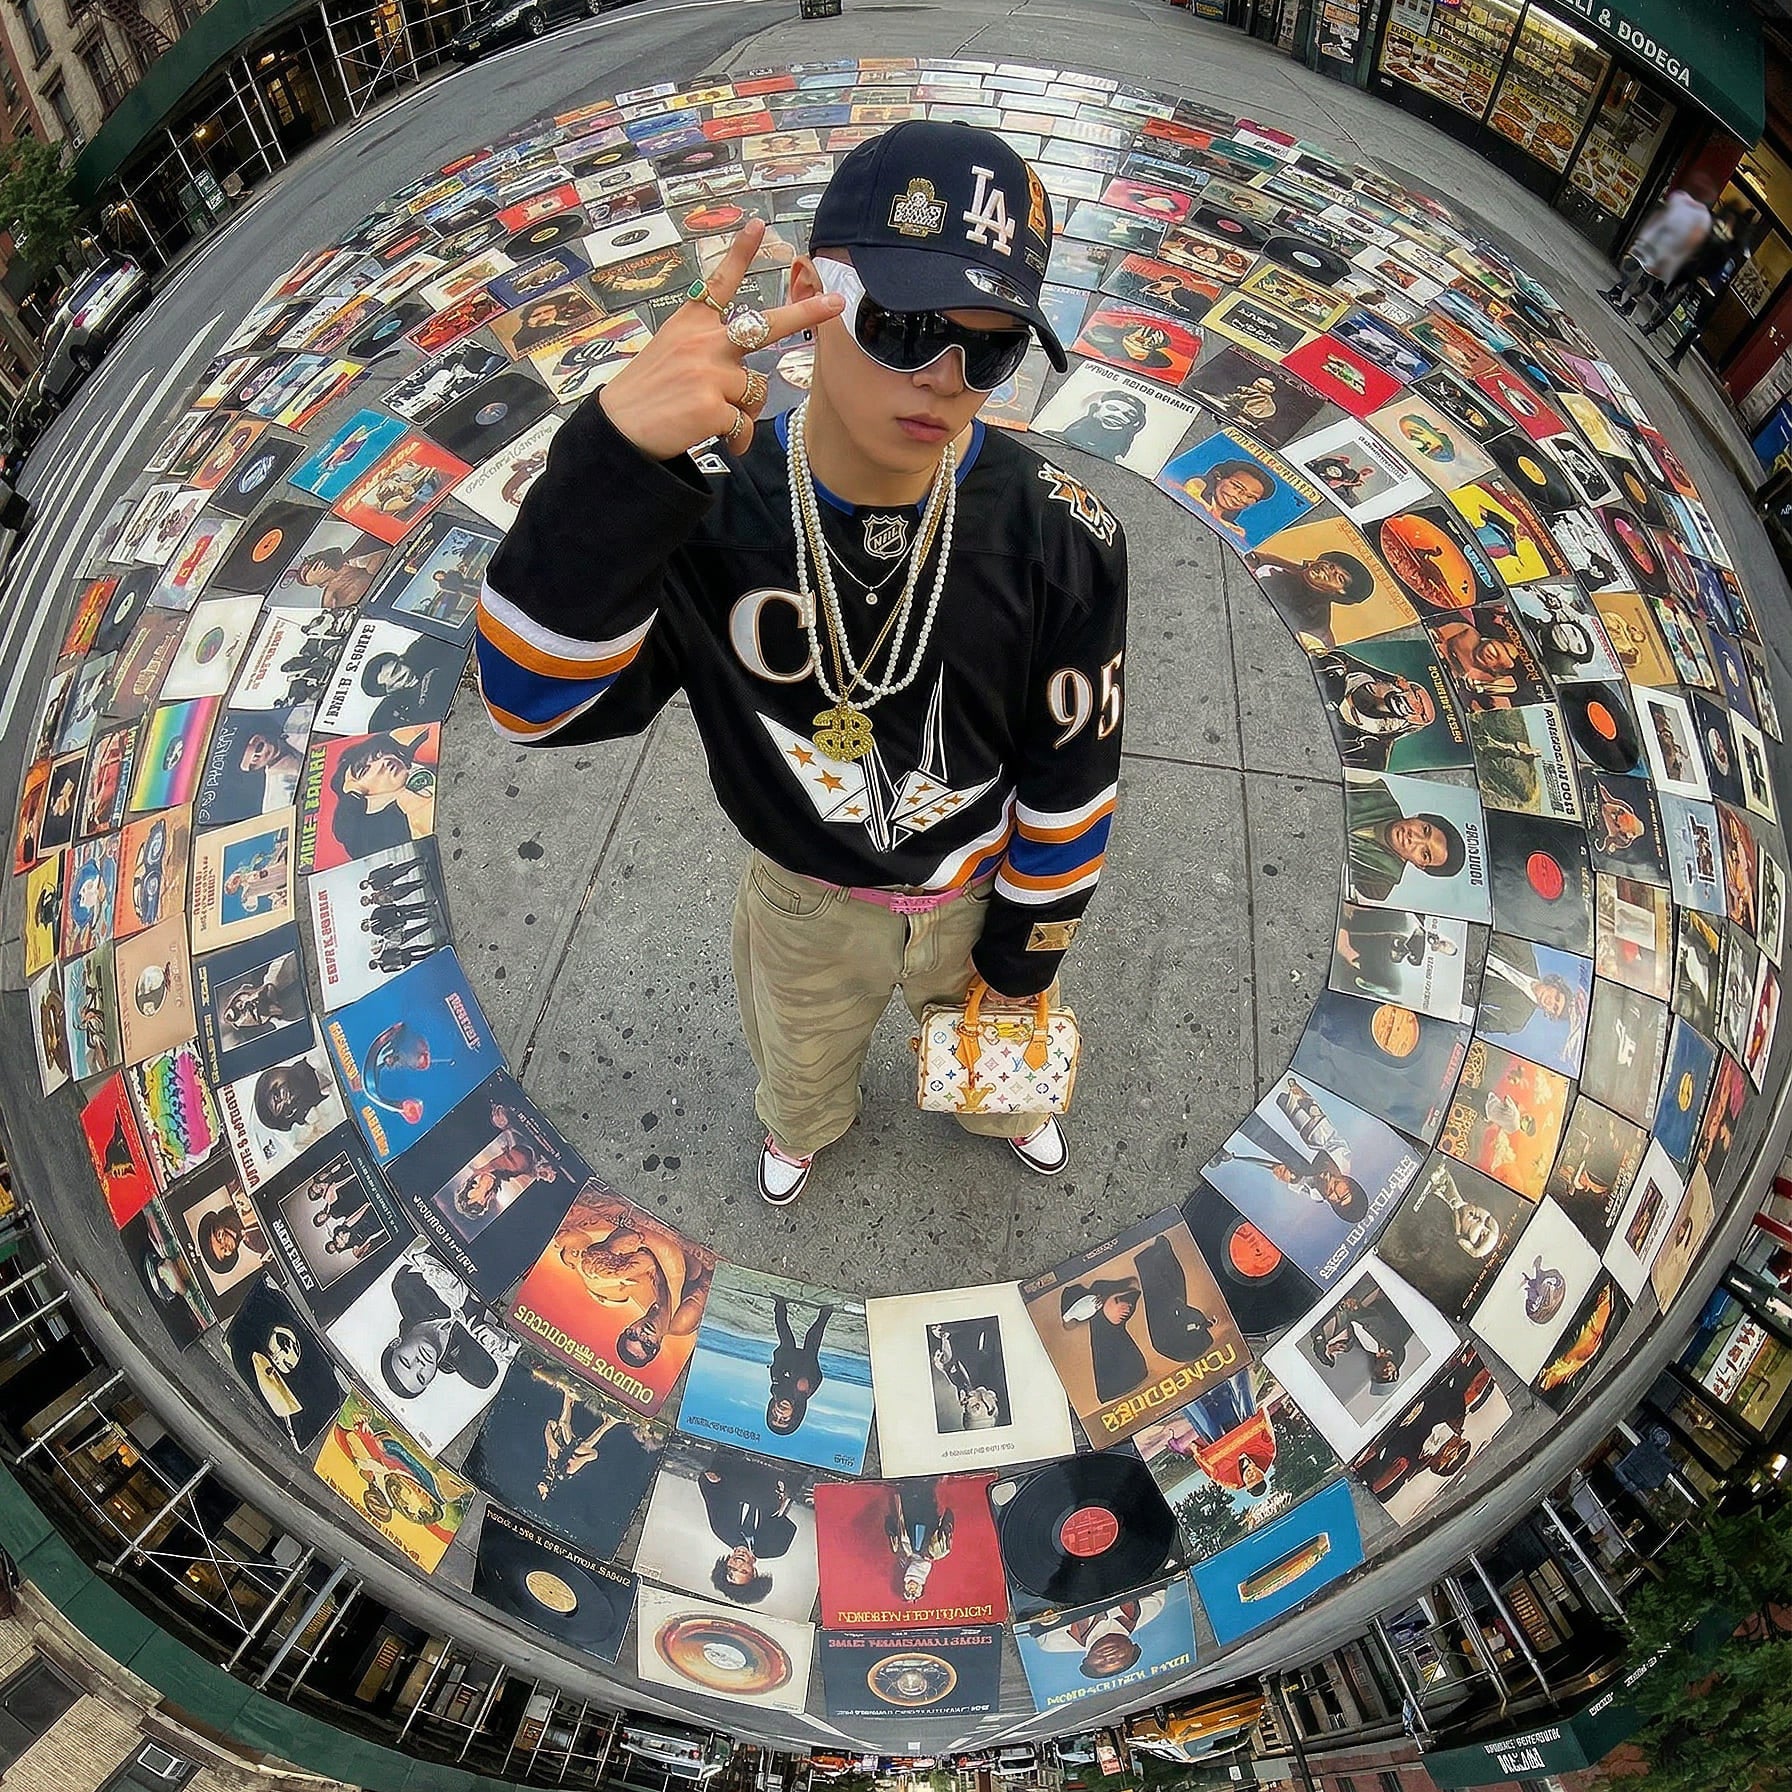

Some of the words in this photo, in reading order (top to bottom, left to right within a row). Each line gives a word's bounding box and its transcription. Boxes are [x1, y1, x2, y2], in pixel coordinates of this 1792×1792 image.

[1598, 8, 1611, 28] &
[962, 165, 1016, 257] LA
[729, 587, 823, 685] C
[1047, 650, 1124, 749] 95
